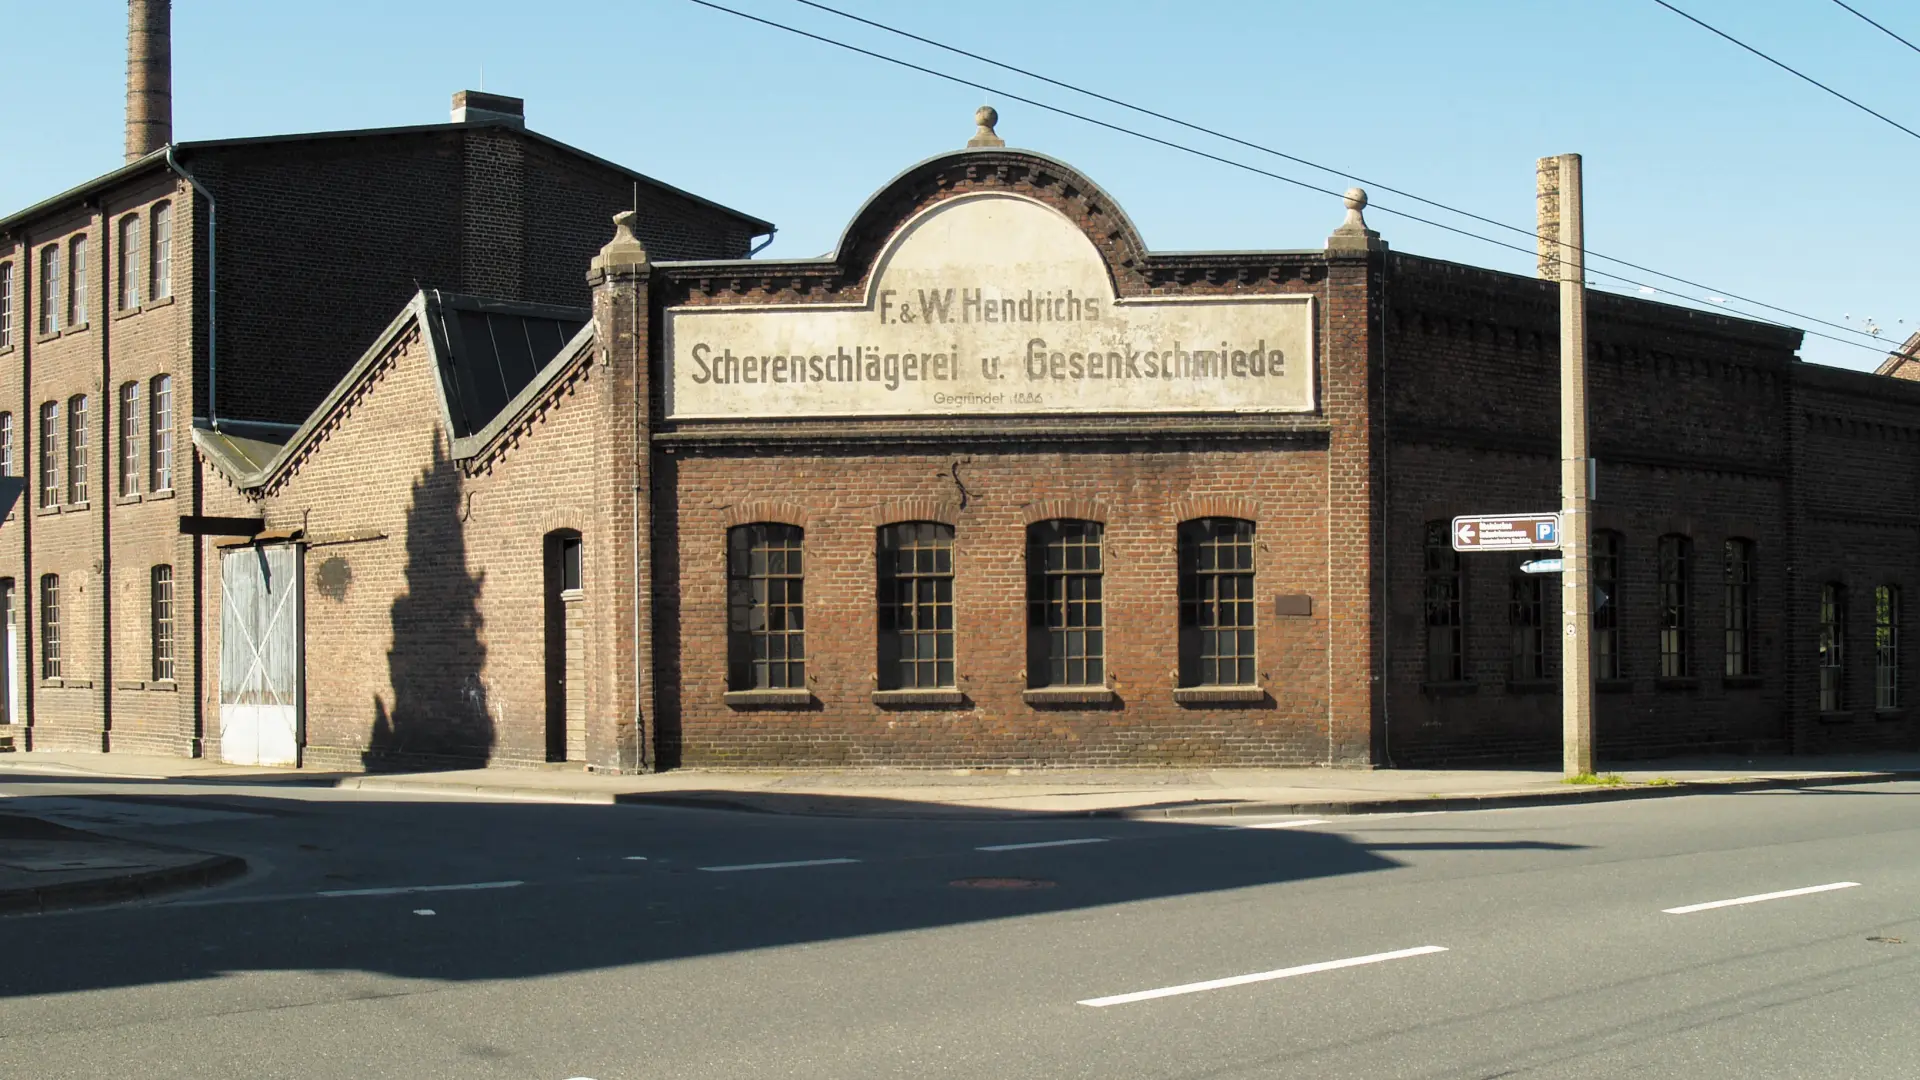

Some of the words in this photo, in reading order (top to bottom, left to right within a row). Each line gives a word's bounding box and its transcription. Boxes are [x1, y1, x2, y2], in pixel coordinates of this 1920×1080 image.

[691, 343, 958, 391] Scherenschlägerei
[981, 356, 1005, 380] u.
[1027, 337, 1285, 380] Gesenkschmiede
[933, 391, 1005, 407] Gegründet
[1539, 524, 1551, 540] P
